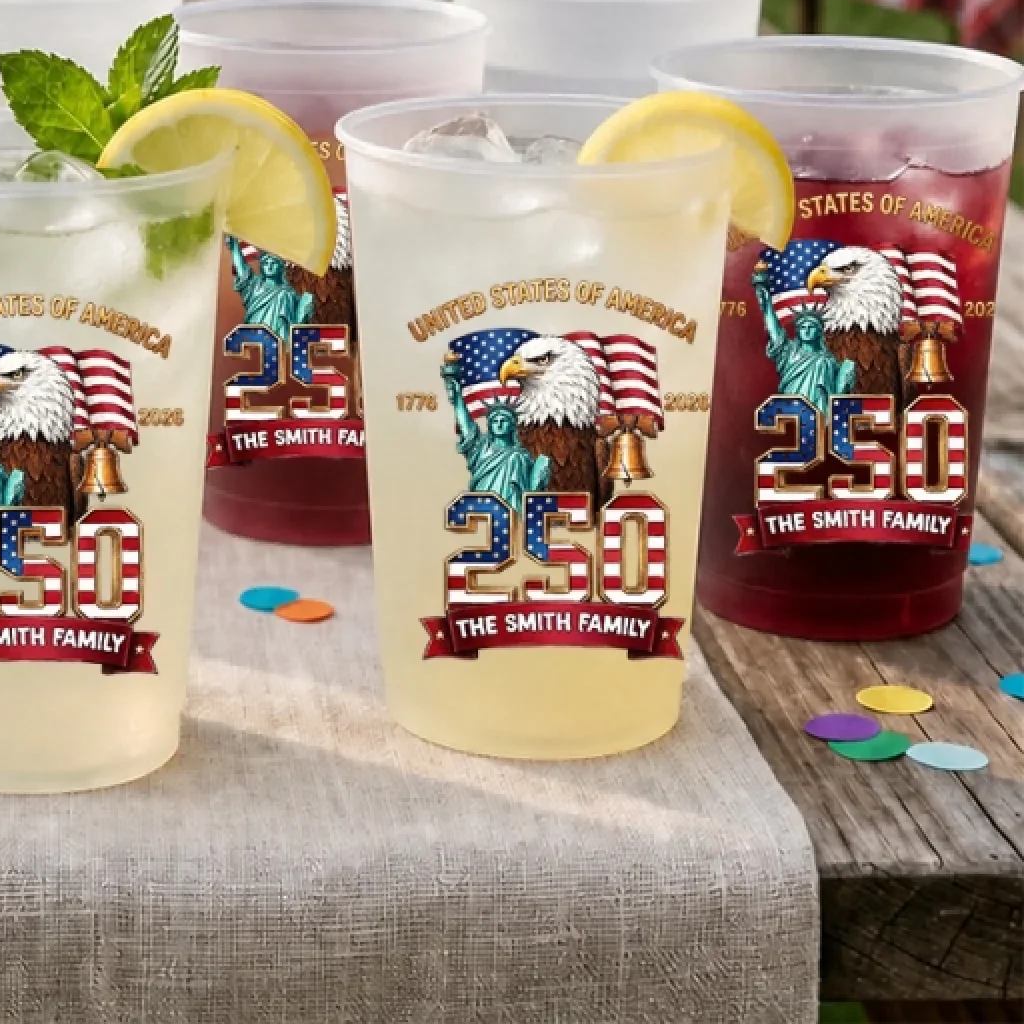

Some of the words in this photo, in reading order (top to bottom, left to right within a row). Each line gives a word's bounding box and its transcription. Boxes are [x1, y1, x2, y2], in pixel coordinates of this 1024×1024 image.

[798, 191, 873, 219] STATES
[880, 193, 906, 215] OF
[909, 201, 995, 253] AMERICA
[49, 294, 79, 320] OF
[78, 301, 173, 360] AMERICA
[407, 292, 487, 342] UNITED
[489, 278, 571, 309] STATES
[575, 280, 605, 304] OF
[605, 285, 699, 345] AMERICA
[718, 301, 747, 317] 776
[963, 300, 996, 317] 202
[223, 324, 363, 426] 25
[231, 431, 268, 451] THE
[274, 428, 332, 445] SMITH
[755, 394, 969, 506] 250
[765, 513, 806, 535] THE
[811, 509, 875, 529] SMITH
[883, 511, 952, 536] FAMILY
[445, 490, 670, 610] 250
[53, 627, 125, 654] FAMILY
[455, 616, 497, 639] THE
[503, 612, 571, 633] SMITH
[578, 613, 651, 639] FAMILY
